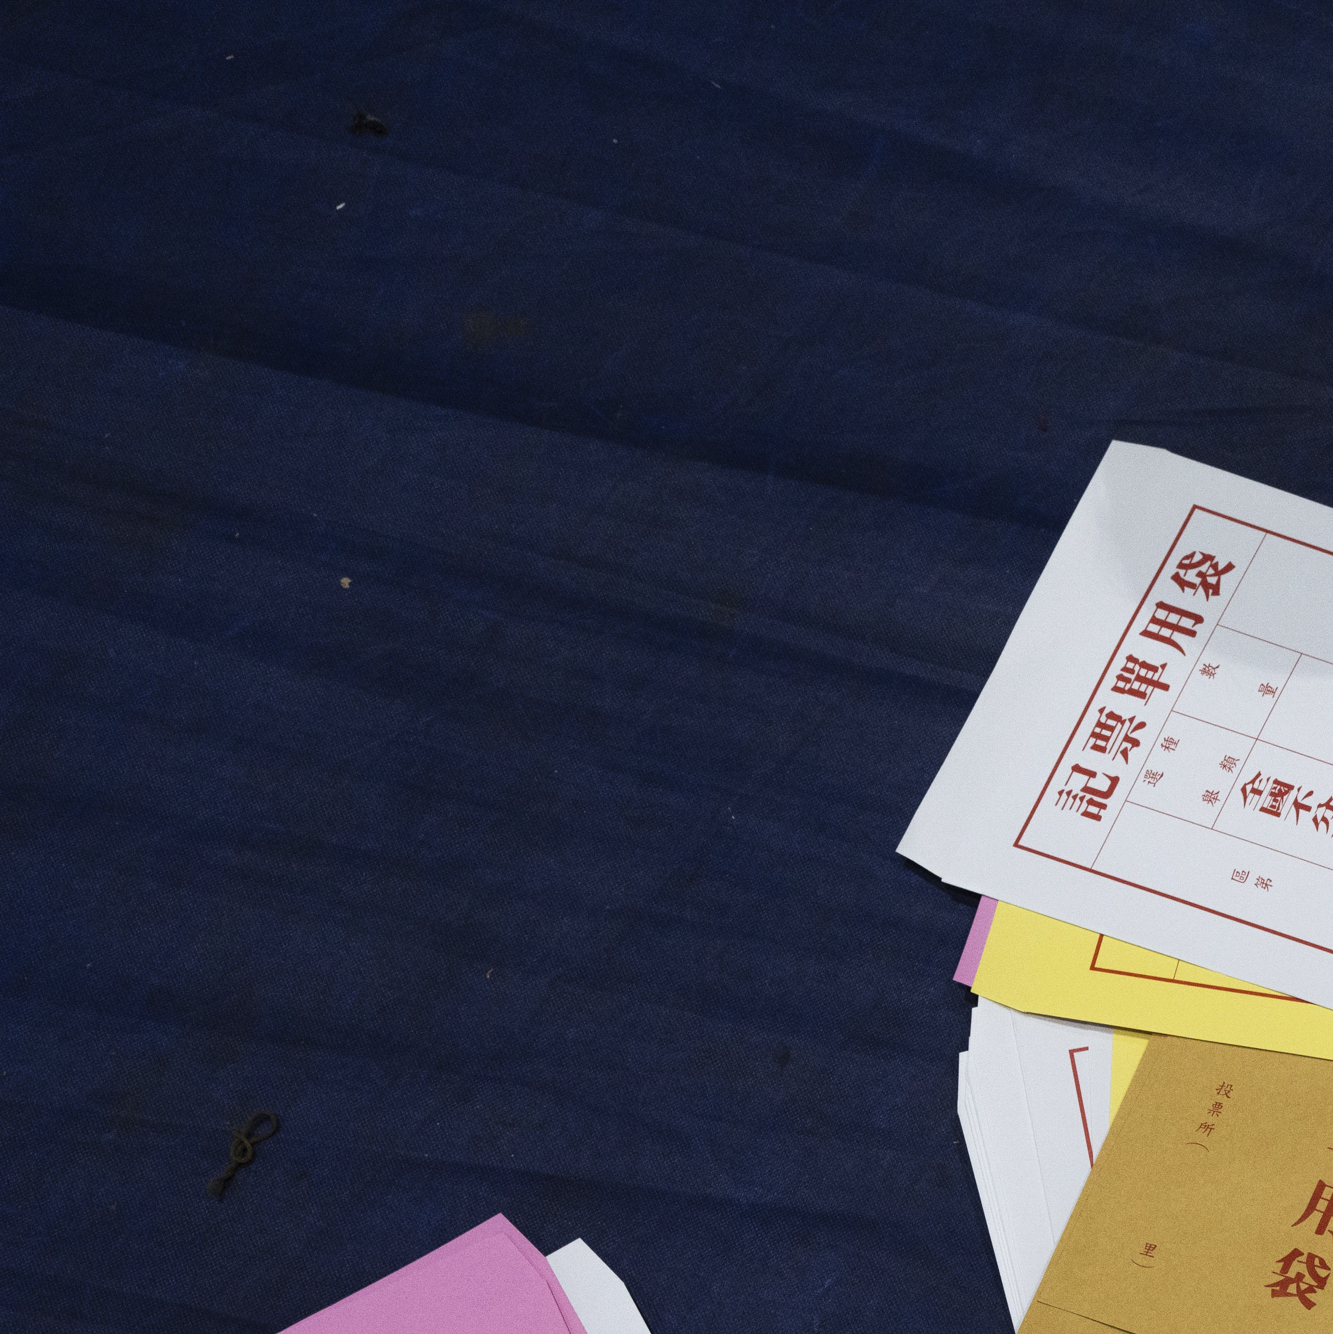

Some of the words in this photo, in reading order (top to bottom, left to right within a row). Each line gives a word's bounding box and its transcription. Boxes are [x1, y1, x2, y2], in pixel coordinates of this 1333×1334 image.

[1057, 550, 1236, 822] 記票單用袋
[1199, 663, 1279, 698] 數量
[1160, 736, 1240, 773] 種類
[1143, 769, 1220, 806] 選舉
[1230, 869, 1273, 891] 區第
